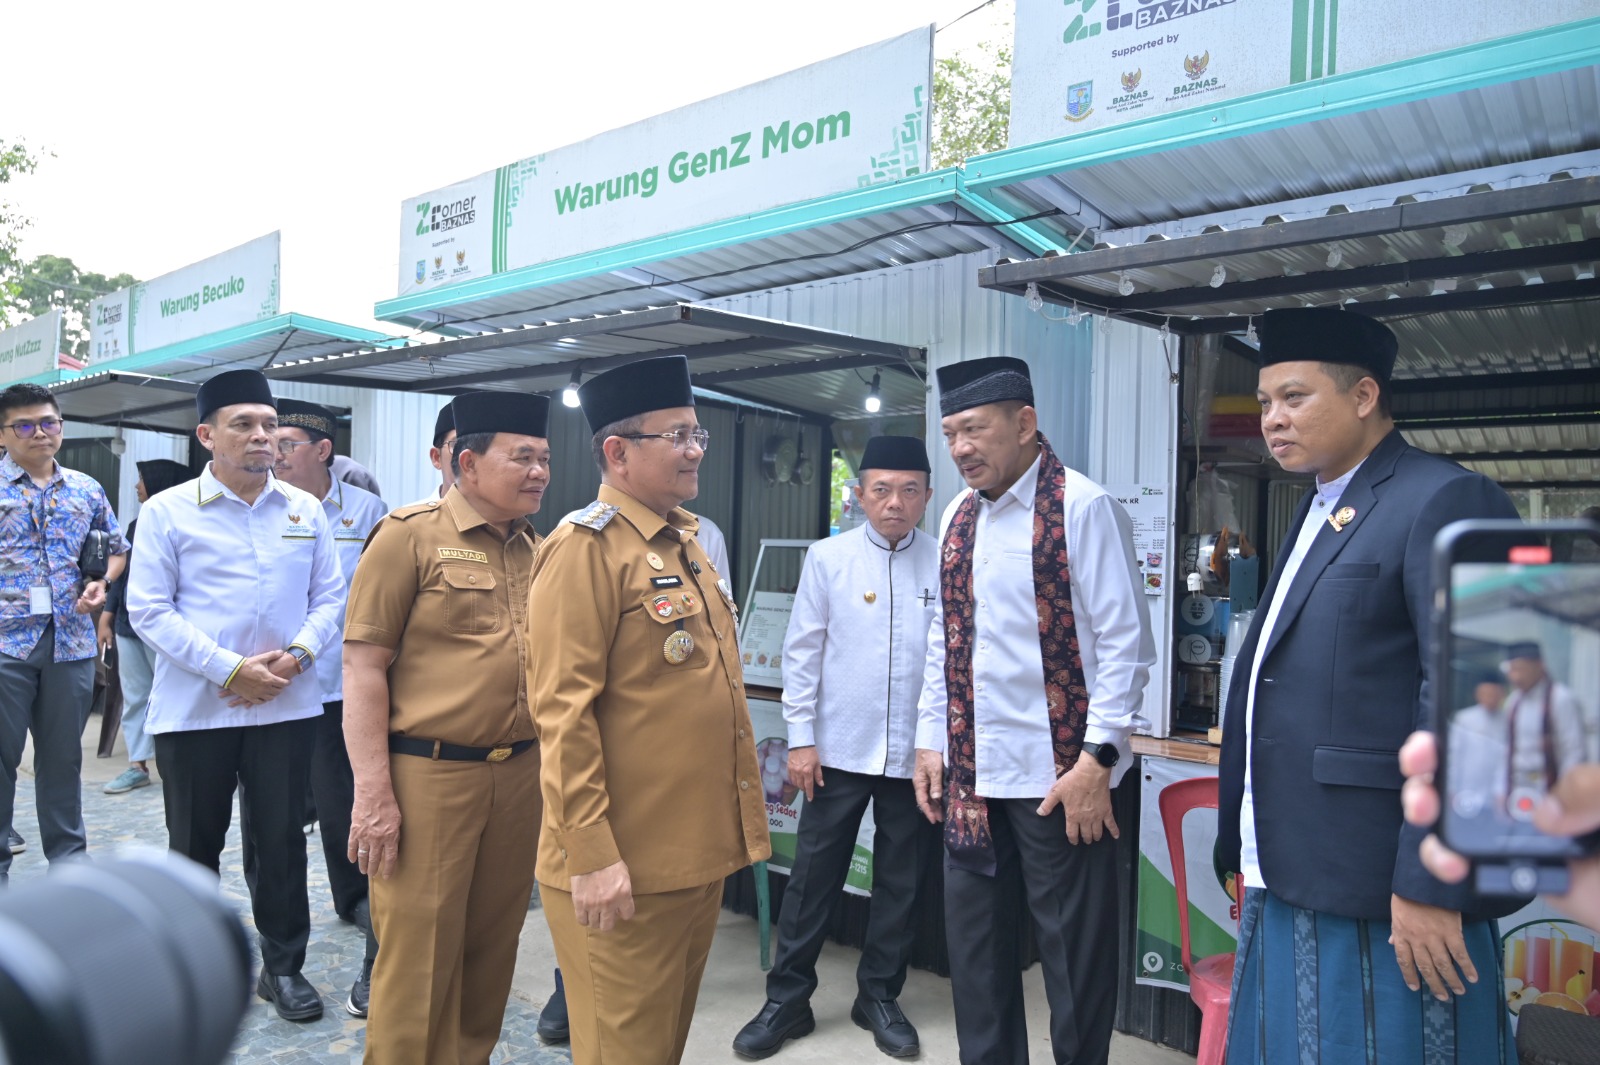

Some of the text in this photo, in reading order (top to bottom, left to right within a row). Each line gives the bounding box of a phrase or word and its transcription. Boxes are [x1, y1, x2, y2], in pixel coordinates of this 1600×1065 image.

[1111, 33, 1180, 58] Supported by
[1173, 77, 1218, 95] BAZNAS
[1112, 90, 1149, 105] BAZNAS
[554, 110, 851, 216] Warung GenZ Mom
[442, 210, 476, 232] BAZNAS
[160, 275, 245, 319] Warung Becuko
[442, 549, 485, 560] MULYADI
[775, 801, 798, 819] Sedot
